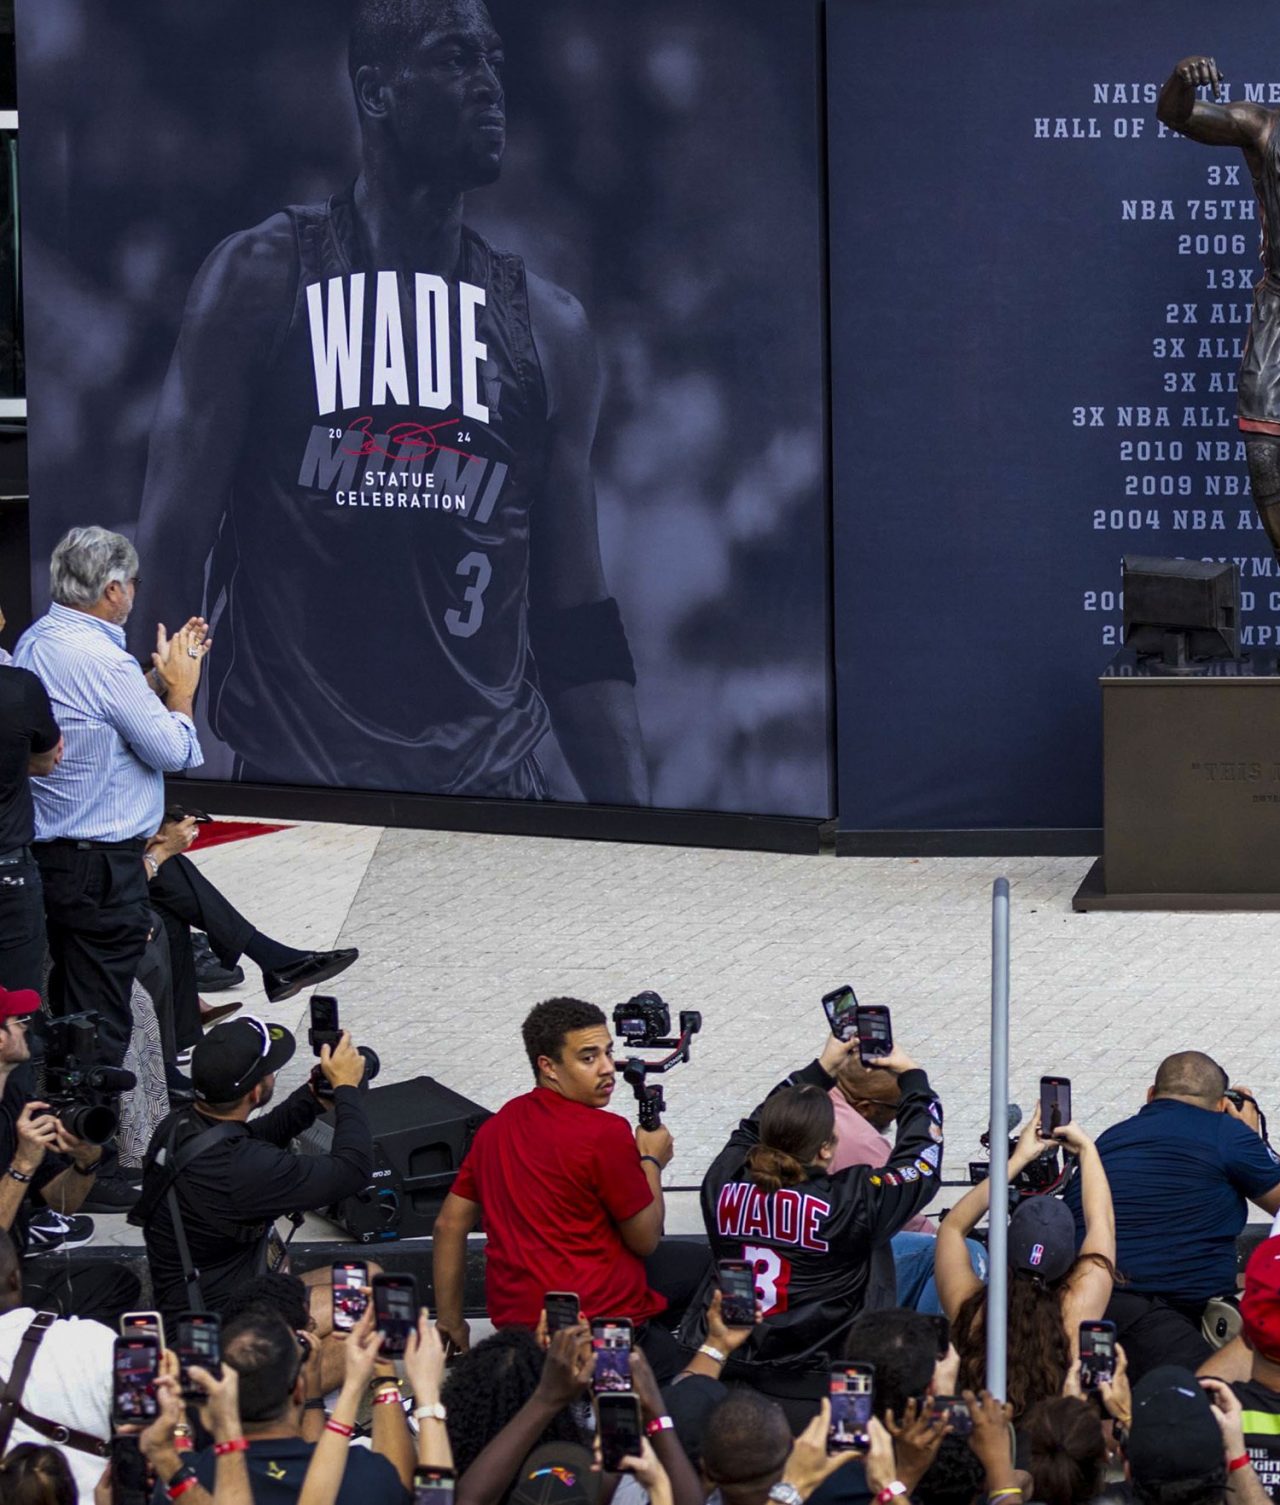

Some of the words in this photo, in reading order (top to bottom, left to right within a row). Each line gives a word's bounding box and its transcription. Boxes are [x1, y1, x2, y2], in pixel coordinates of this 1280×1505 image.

[1093, 83, 1231, 104] NAISTH
[1034, 118, 1102, 139] HALL
[1114, 118, 1145, 139] OF
[1207, 166, 1240, 185] 3X
[1122, 200, 1175, 220] NBA
[1187, 200, 1255, 220] 75TH
[1178, 234, 1246, 254] 2006
[1206, 269, 1254, 289] 13X
[1166, 304, 1198, 323] 2X
[306, 271, 489, 424] WADE
[1153, 338, 1185, 358] 3X
[1164, 373, 1196, 392] 3X
[1072, 407, 1105, 427] 3X
[1117, 407, 1170, 427] NBA
[328, 428, 342, 439] 20
[457, 432, 471, 443] 24
[1120, 441, 1183, 461] 2010
[1196, 441, 1247, 461] NBA
[298, 425, 508, 524] MIAMI
[365, 471, 435, 488] STATUE
[1125, 476, 1192, 495] 2009
[335, 491, 466, 510] CELEBRATION
[1093, 510, 1160, 530] 2004
[1172, 510, 1225, 530] NBA
[444, 551, 492, 638] 3
[717, 1183, 831, 1253] WADE
[742, 1245, 791, 1318] 3
